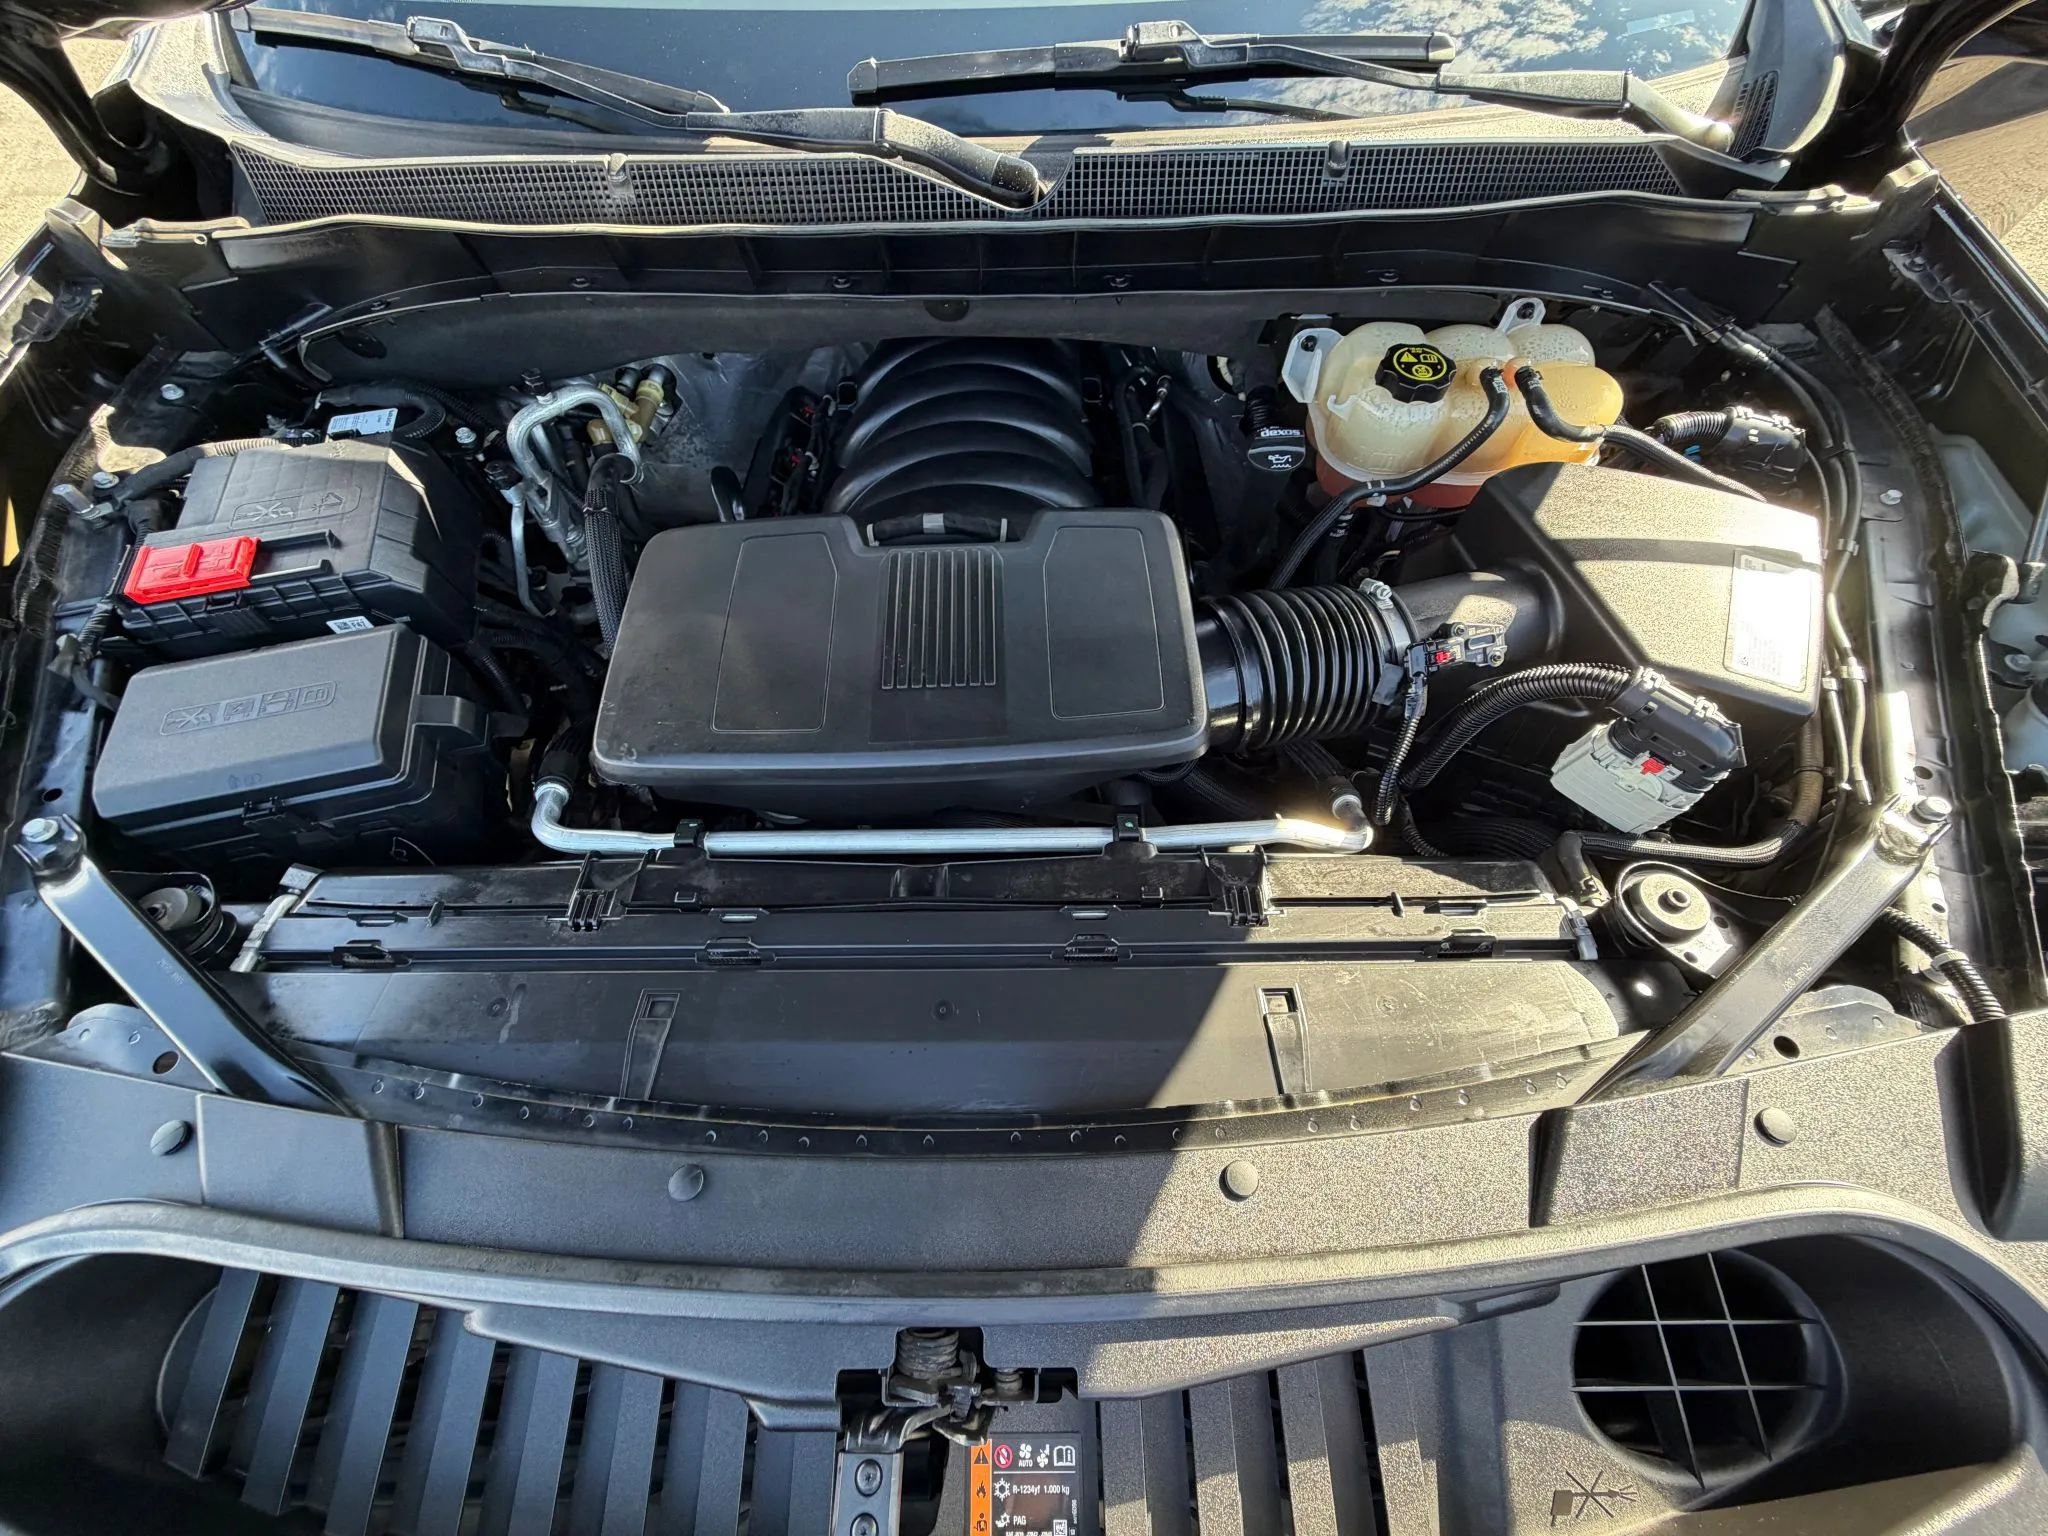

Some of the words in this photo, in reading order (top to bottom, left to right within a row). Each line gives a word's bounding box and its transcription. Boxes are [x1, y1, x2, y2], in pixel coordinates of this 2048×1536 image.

[1260, 428, 1301, 437] dexos
[1018, 1459, 1033, 1468] AUTO
[1012, 1484, 1041, 1495] R-1234yf
[1043, 1484, 1061, 1494] 1.000
[1061, 1484, 1070, 1495] kg
[1013, 1515, 1027, 1526] PAG
